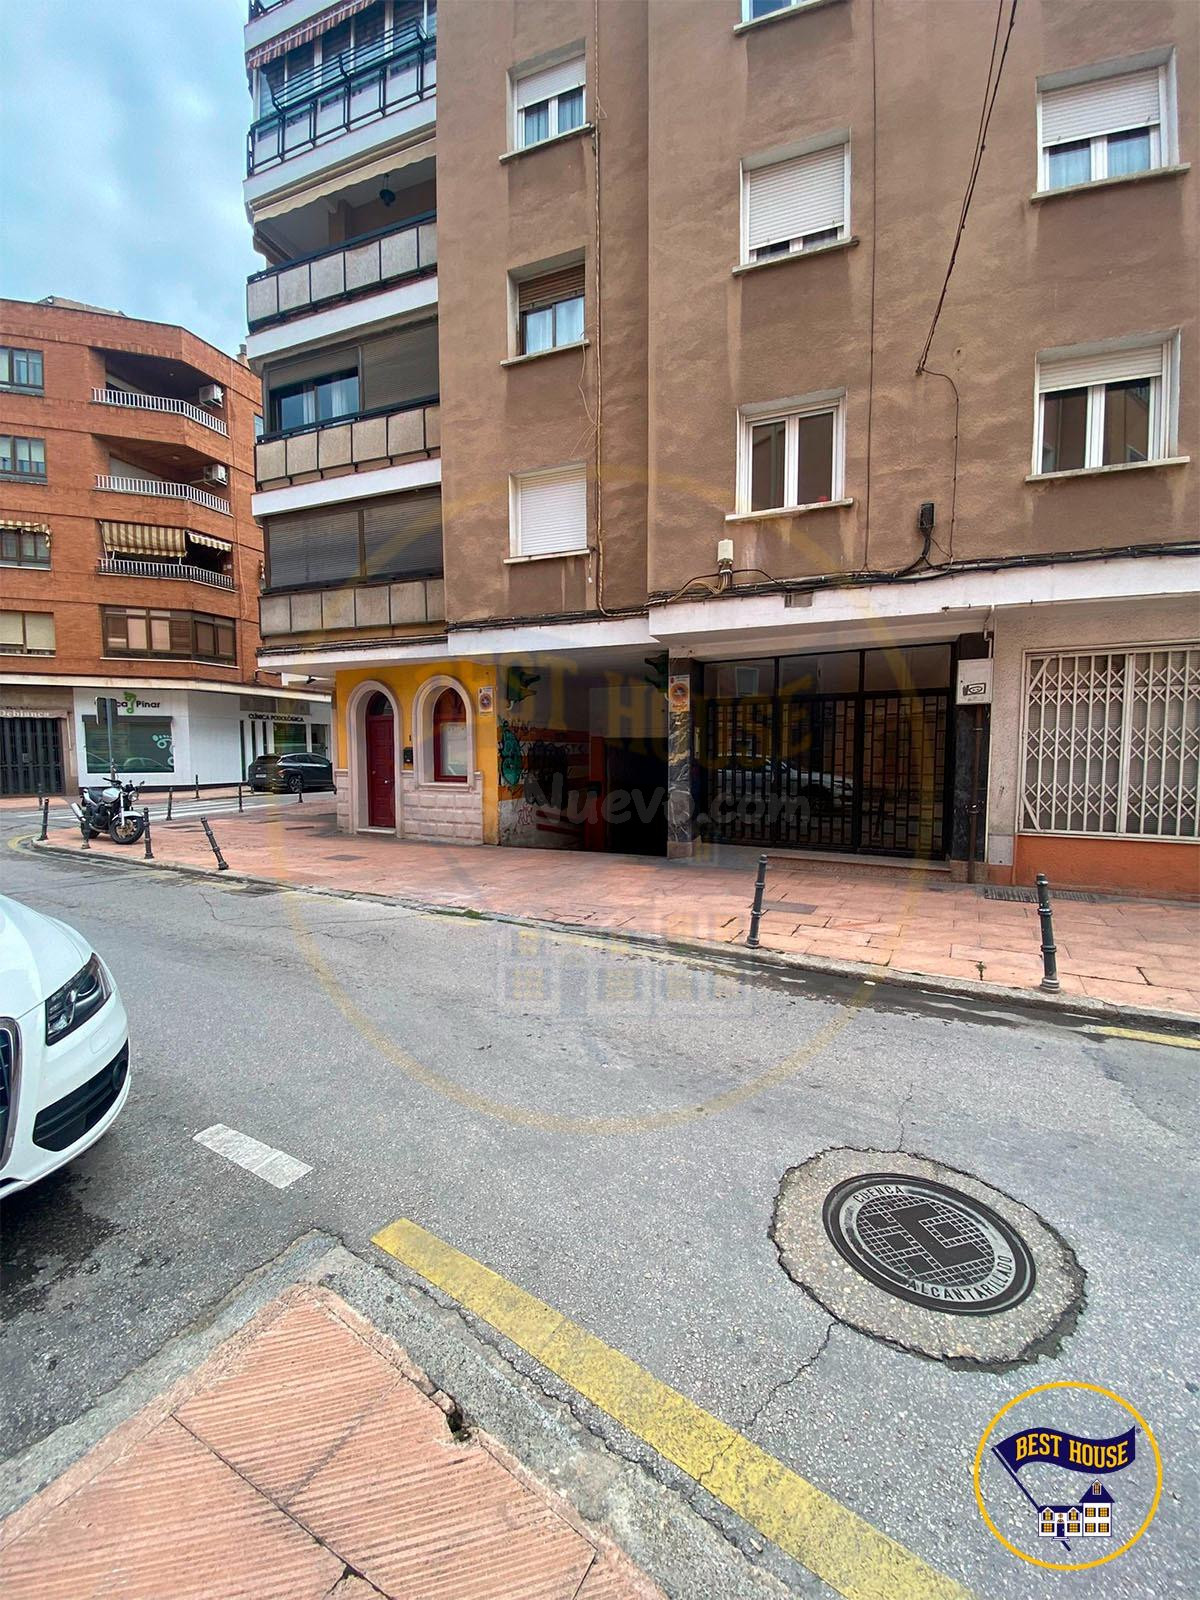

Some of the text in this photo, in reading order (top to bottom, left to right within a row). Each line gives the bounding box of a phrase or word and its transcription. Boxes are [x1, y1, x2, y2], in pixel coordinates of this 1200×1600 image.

[136, 700, 161, 708] Pinar
[853, 1185, 905, 1204] CUENCA
[908, 1254, 1013, 1302] ALCANTARILLADO
